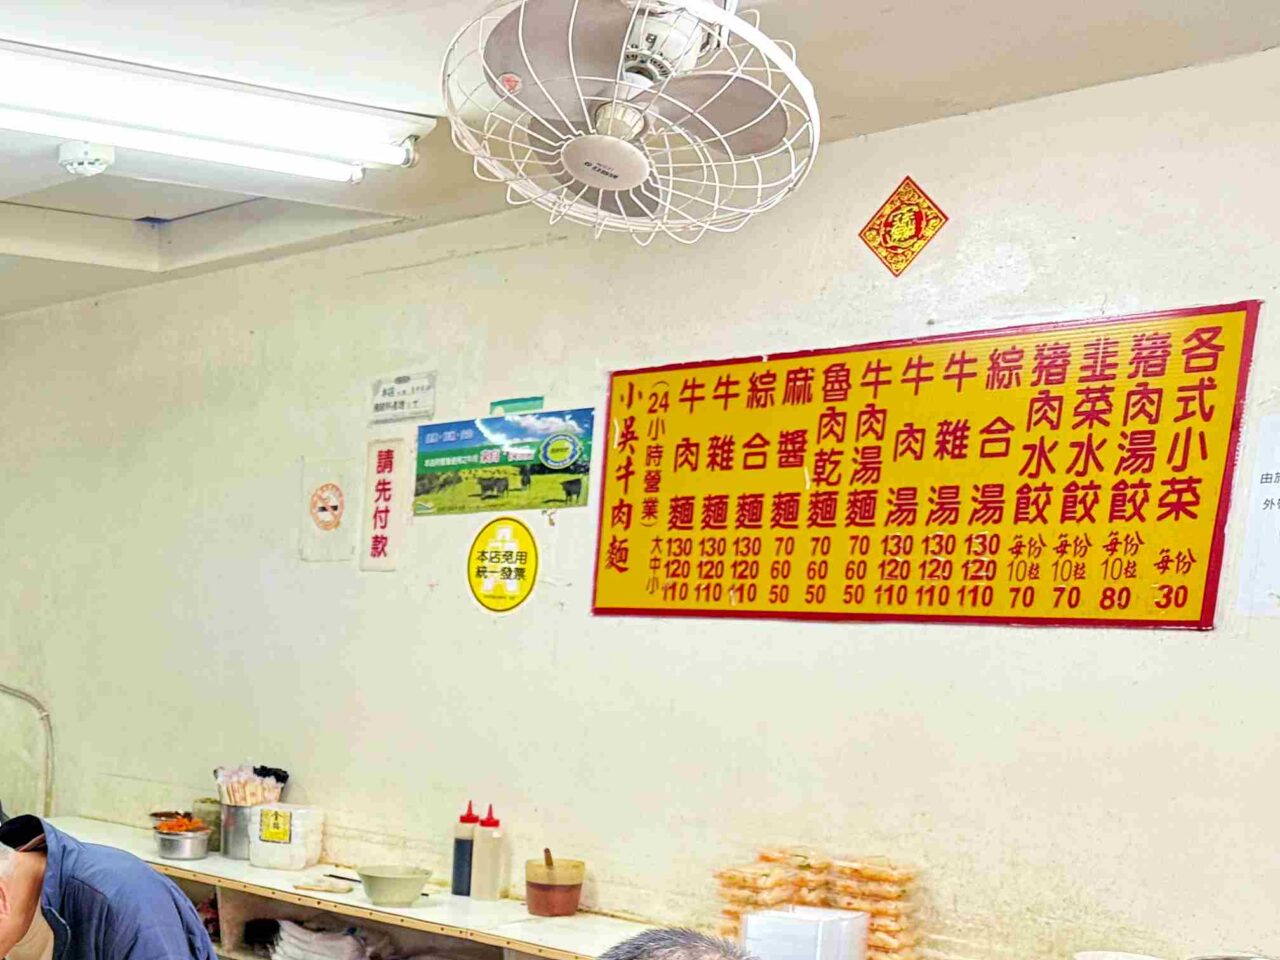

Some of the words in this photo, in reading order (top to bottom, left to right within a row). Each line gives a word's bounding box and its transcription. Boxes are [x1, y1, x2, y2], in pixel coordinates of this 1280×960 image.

[606, 382, 642, 573] 小吳牛肉麵
[668, 378, 705, 531] 牛肉麵
[701, 374, 740, 530] 牛雜麵
[735, 370, 777, 530] 綜合麵
[770, 367, 814, 529] 麻醬麵
[807, 363, 852, 529] 魯肉乾麵
[845, 359, 892, 528] 牛肉湯麵
[885, 355, 934, 528] 牛肉湯
[926, 350, 978, 526] 牛雜湯
[968, 346, 1025, 525] 綜合湯
[1014, 342, 1071, 524] 豬肉水餃
[1060, 337, 1120, 524] 韭菜水餃
[1109, 332, 1172, 523] 豬肉湯餃
[1157, 326, 1225, 521] 各式小菜
[370, 449, 394, 558] 請先付款
[475, 566, 527, 580] 統一發票
[476, 550, 528, 565] 本店免用
[665, 559, 690, 579] 120
[697, 560, 724, 579] 120
[731, 560, 759, 580] 120
[771, 560, 791, 580] 60
[807, 560, 828, 580] 60
[845, 560, 867, 580] 60
[878, 558, 911, 580] 120
[919, 559, 954, 580] 120
[961, 559, 997, 581] 120
[667, 538, 692, 556] 130
[699, 537, 726, 556] 130
[733, 537, 762, 556] 130
[775, 536, 794, 556] 70
[811, 536, 831, 556] 70
[849, 535, 870, 555] 70
[881, 534, 913, 556] 130
[921, 534, 956, 556] 130
[965, 533, 1000, 555] 130
[1007, 559, 1040, 582] 10粒
[1008, 533, 1047, 559] 每份
[1051, 560, 1086, 582] 10粒
[1052, 532, 1093, 559] 每份
[1102, 530, 1145, 557] 每份
[1102, 557, 1137, 580] 10粒
[1154, 548, 1197, 575] 每份
[662, 583, 688, 601] 110
[694, 583, 722, 602] 110
[730, 583, 757, 603] 110
[769, 584, 789, 604] 50
[805, 584, 826, 604] 50
[843, 584, 865, 604] 50
[874, 585, 908, 605] 110
[915, 585, 950, 607] 110
[957, 585, 993, 607] 110
[1009, 586, 1035, 608] 70
[1053, 586, 1081, 608] 70
[1099, 587, 1131, 610] 80
[1155, 585, 1188, 609] 30
